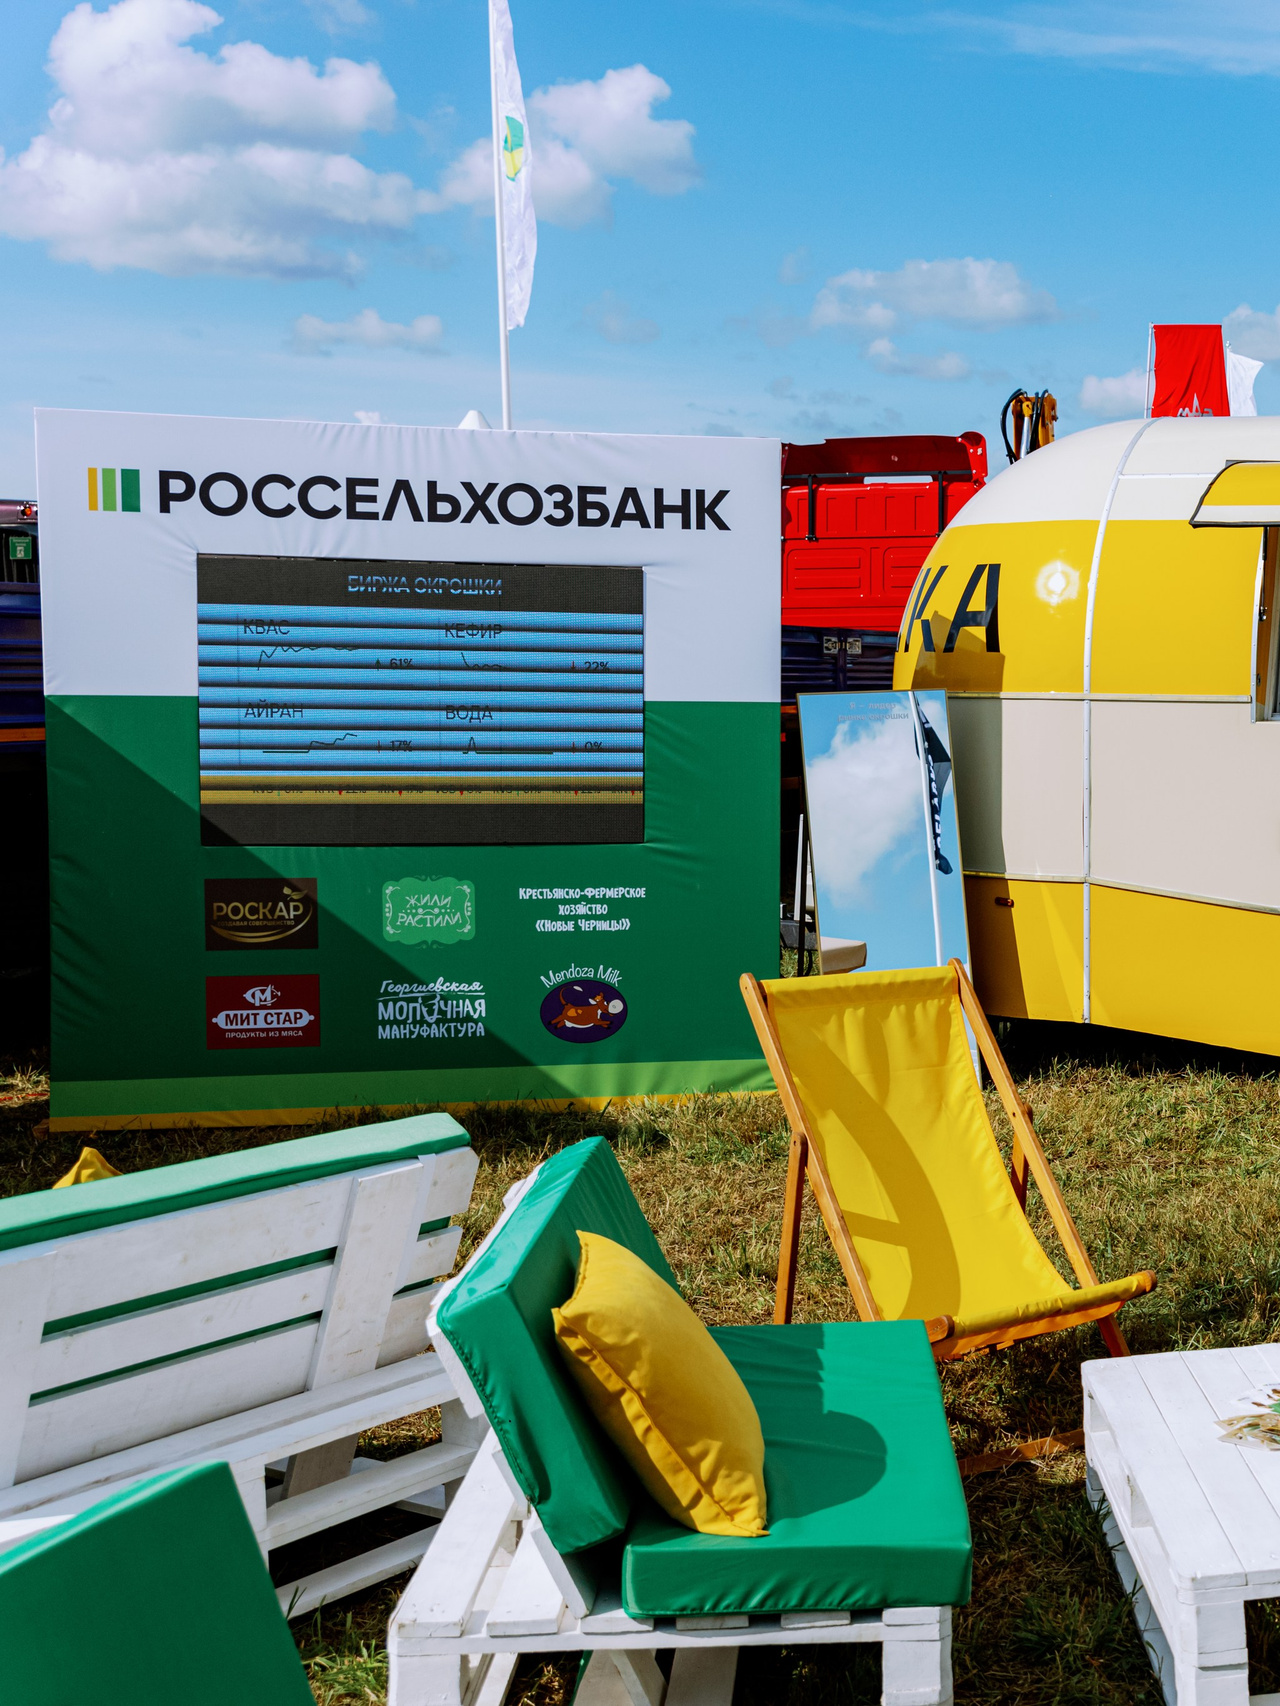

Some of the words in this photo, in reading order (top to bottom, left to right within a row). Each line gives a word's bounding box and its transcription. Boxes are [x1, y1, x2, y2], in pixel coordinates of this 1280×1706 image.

[158, 469, 731, 532] РОССЕЛЬХОЗБАНК
[347, 574, 411, 594] БИРЖА
[414, 576, 502, 596] ОКРОШКИ
[243, 618, 291, 636] КВАС
[444, 622, 504, 639] КЕФИР
[244, 699, 305, 719] АЙРАН
[445, 705, 494, 724] ВОДА
[405, 893, 452, 908] ЖИЛИ
[558, 901, 608, 915] ХОЗЯЙСТВО
[212, 901, 304, 920] РОСКАР
[396, 911, 463, 928] РАСТИЛИ
[540, 963, 594, 988] Mendoza
[597, 964, 622, 987] Milk
[380, 976, 484, 997] Георгиевская
[224, 1012, 259, 1027] МИТ
[263, 1011, 304, 1026] СТАР
[225, 1031, 267, 1039] ПРОДУКТЫ
[378, 1022, 485, 1039] МАНУФАКТУРА
